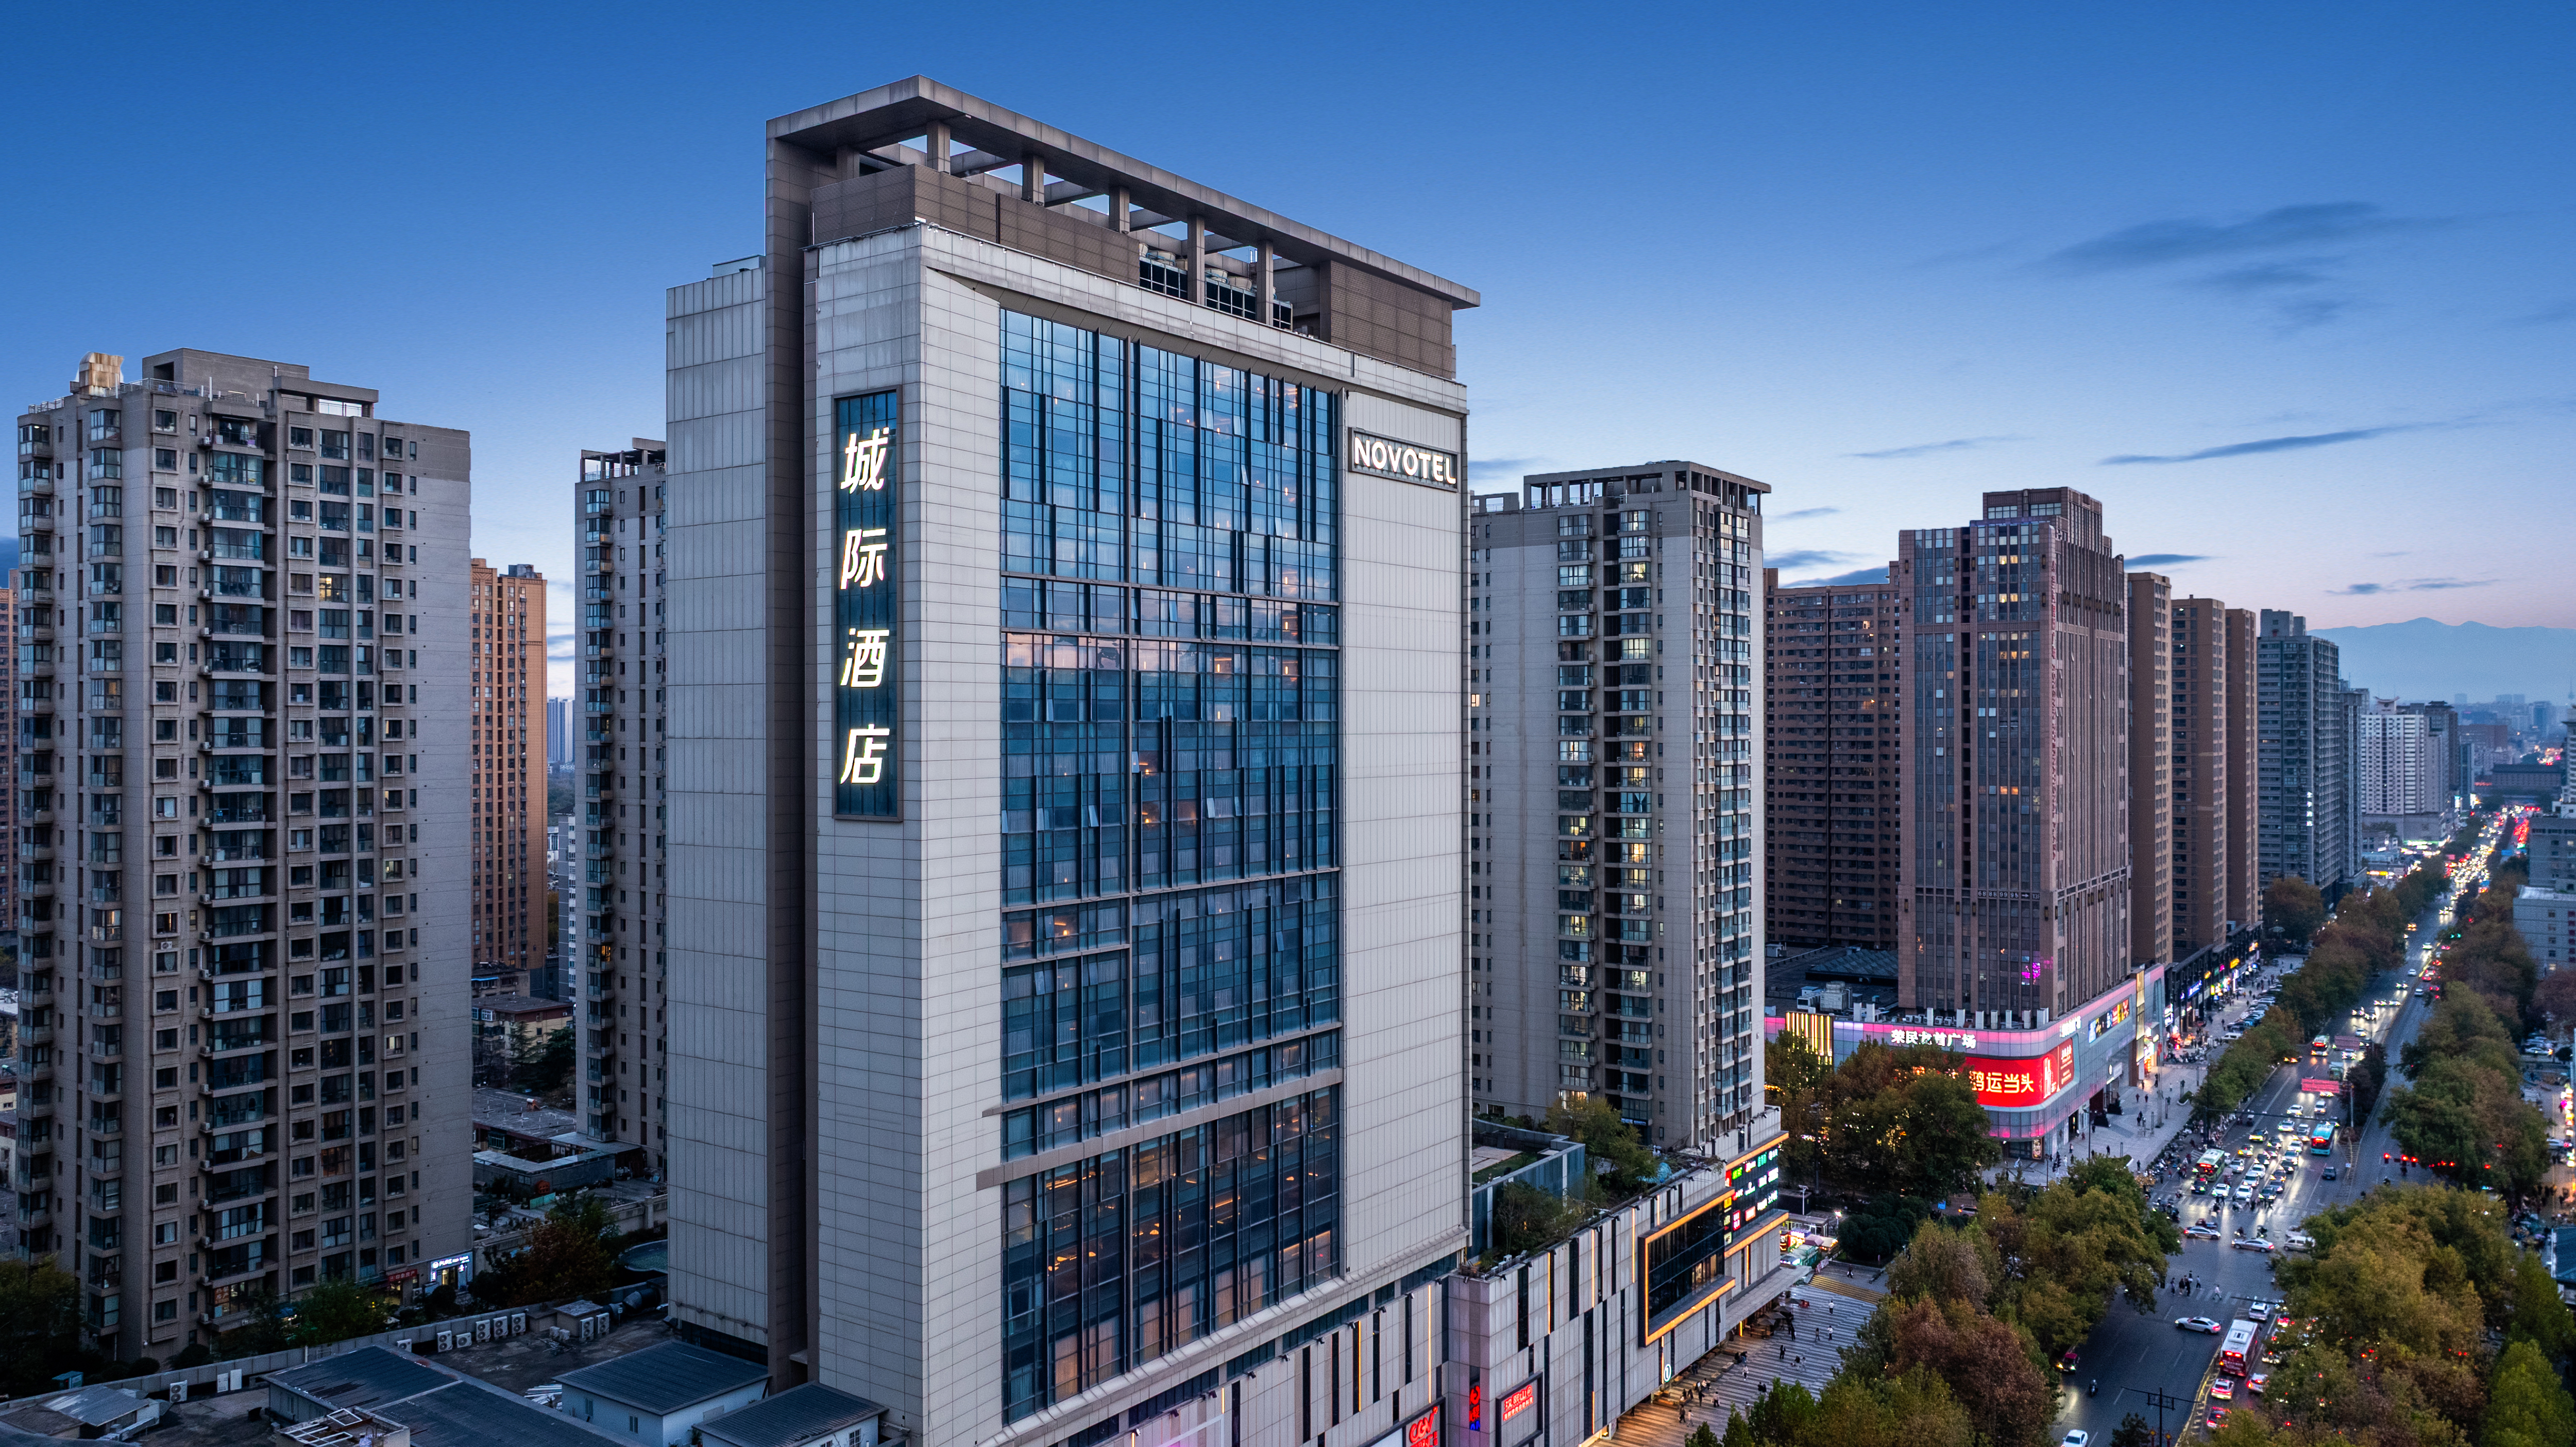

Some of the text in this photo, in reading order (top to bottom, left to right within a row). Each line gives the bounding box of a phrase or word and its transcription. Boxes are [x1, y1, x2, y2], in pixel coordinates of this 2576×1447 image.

[1354, 436, 1456, 484] NOVOTEL
[839, 427, 890, 786] 城际酒店
[1410, 1412, 1435, 1443] CGV
